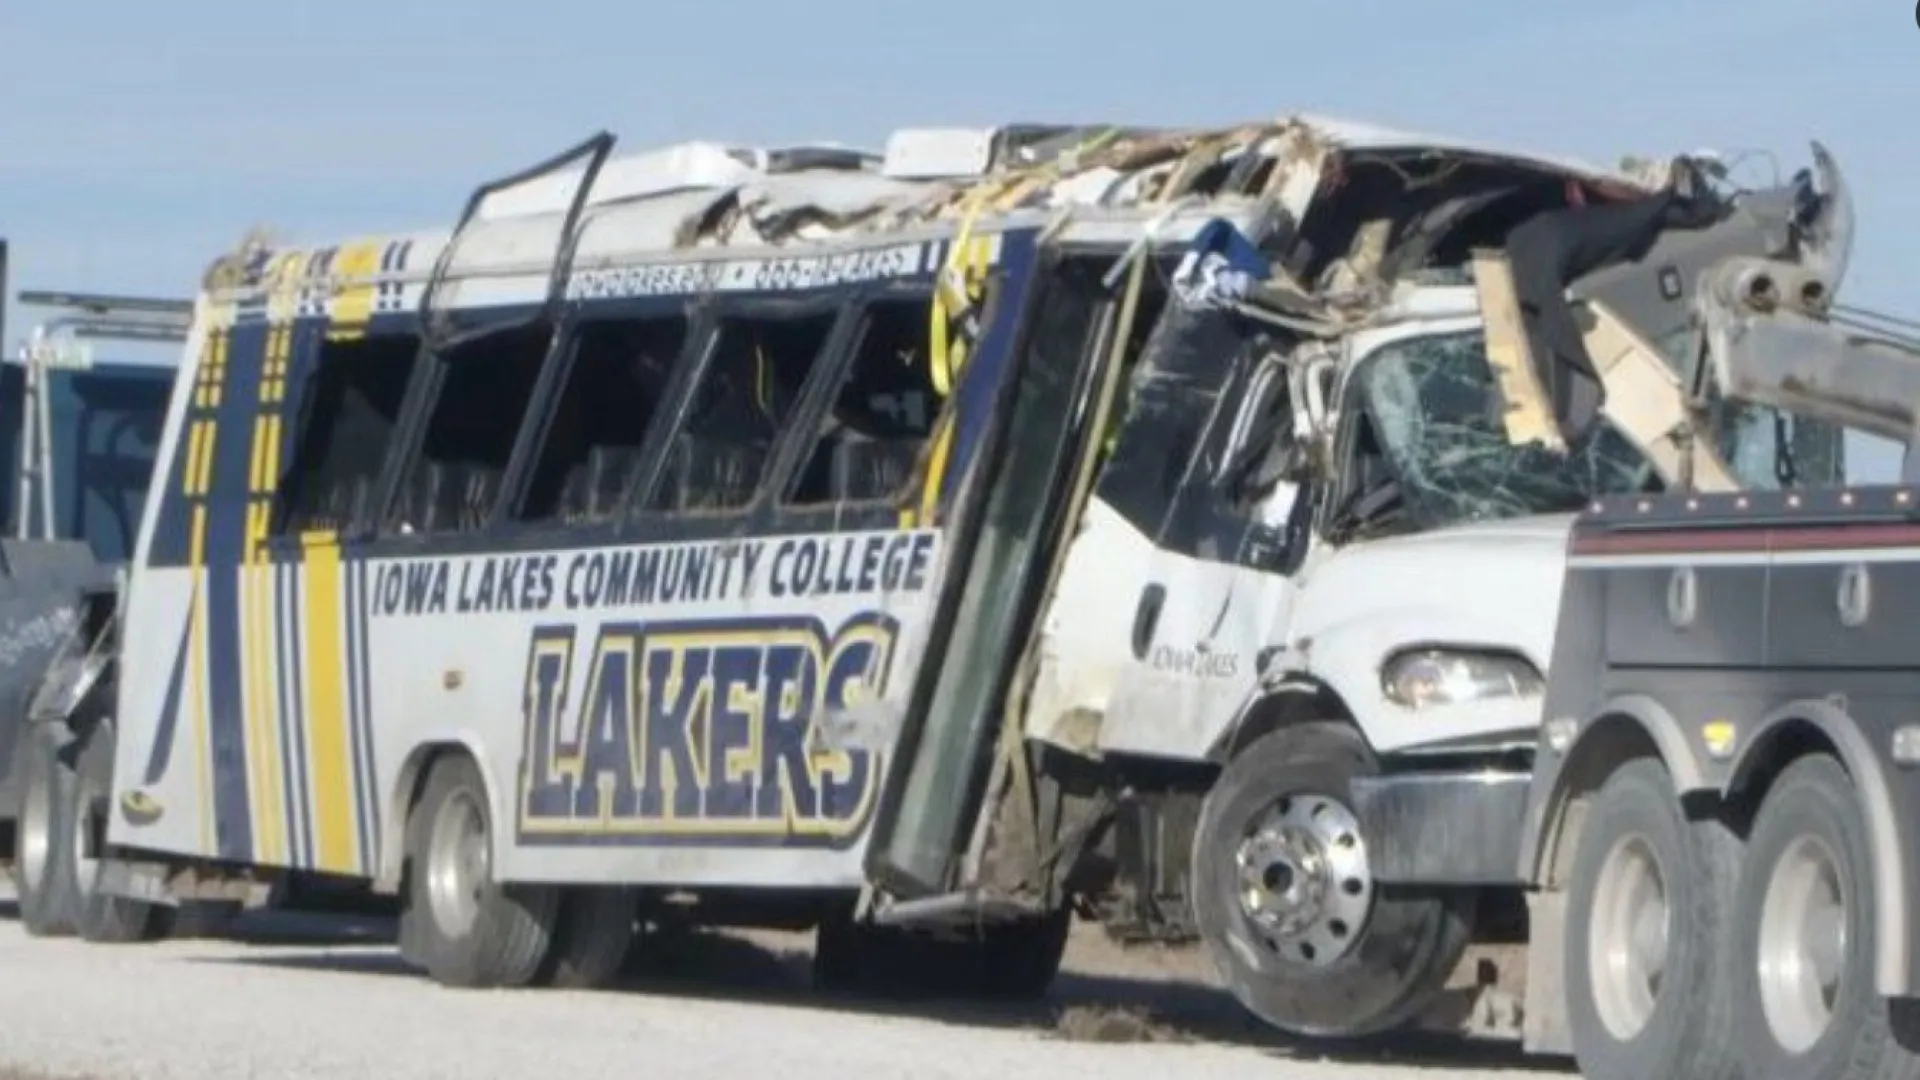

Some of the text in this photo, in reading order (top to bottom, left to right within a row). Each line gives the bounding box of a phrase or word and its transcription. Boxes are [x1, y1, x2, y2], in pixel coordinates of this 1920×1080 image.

[371, 533, 934, 617] IOWA LAKES COMMUNITY COLLEGE
[516, 611, 900, 849] LAKERS
